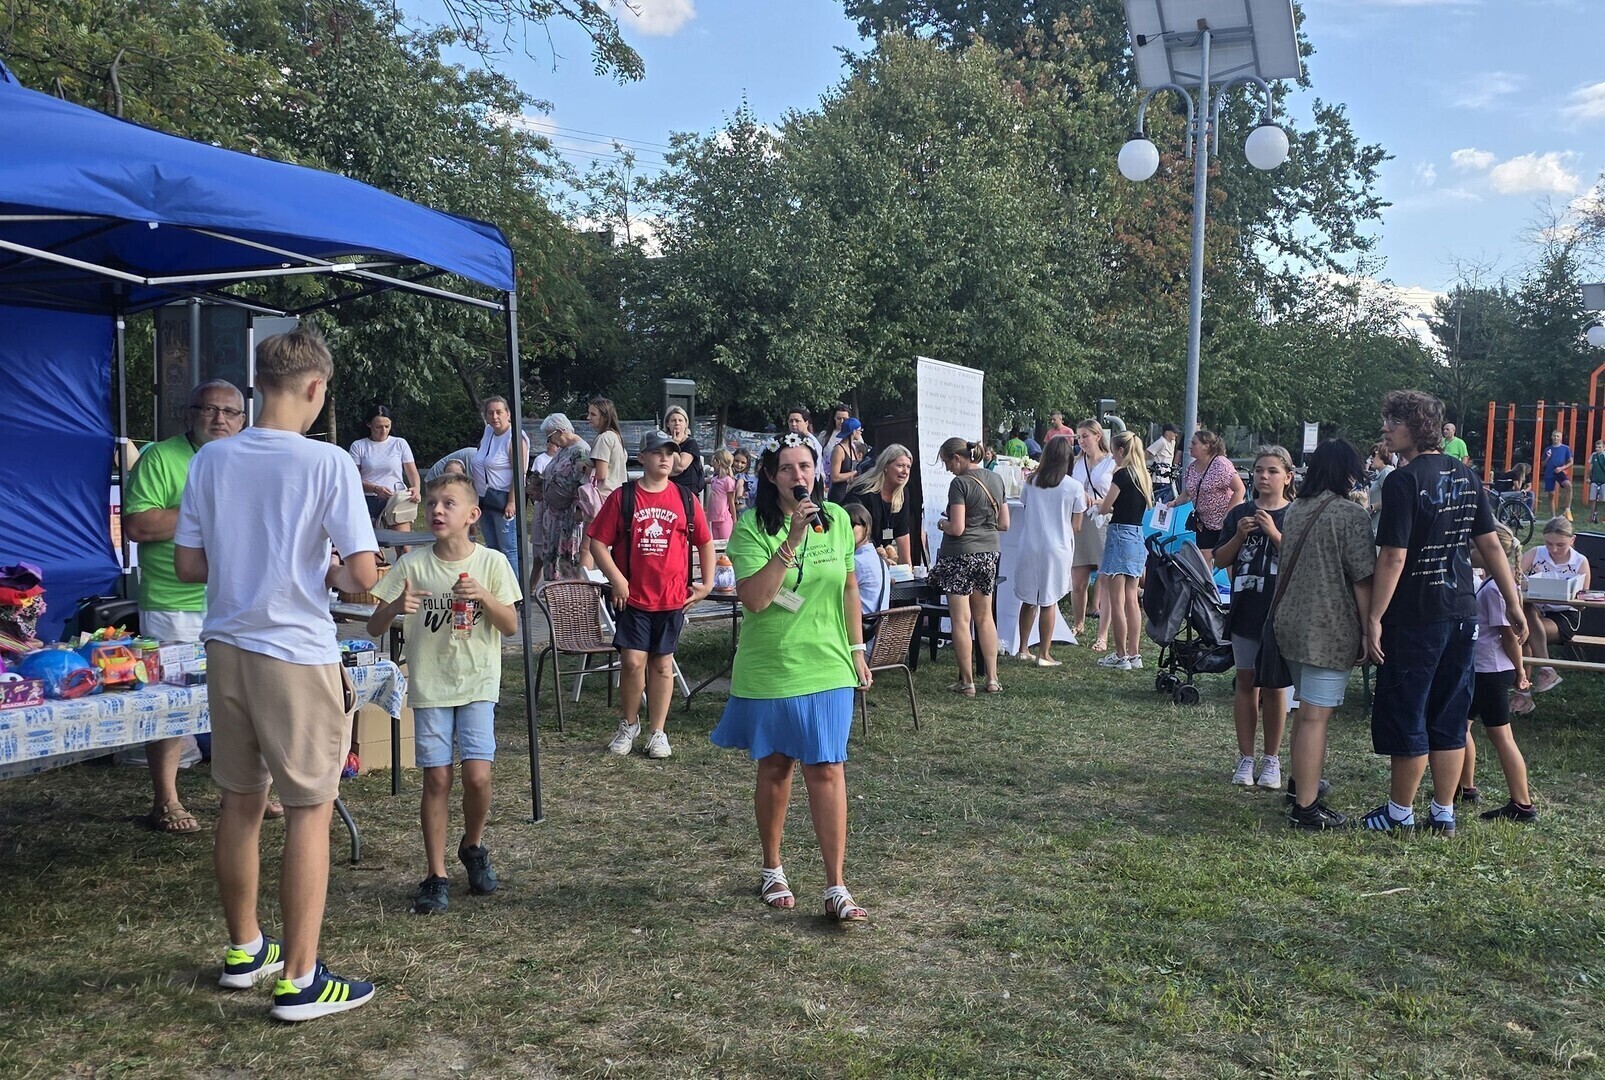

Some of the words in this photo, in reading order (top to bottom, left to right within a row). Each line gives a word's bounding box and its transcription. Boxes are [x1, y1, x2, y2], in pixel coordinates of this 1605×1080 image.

[634, 507, 678, 523] KENTUCKY
[1242, 535, 1264, 546] ISA
[423, 599, 457, 610] FOLLO
[424, 610, 483, 633] We
